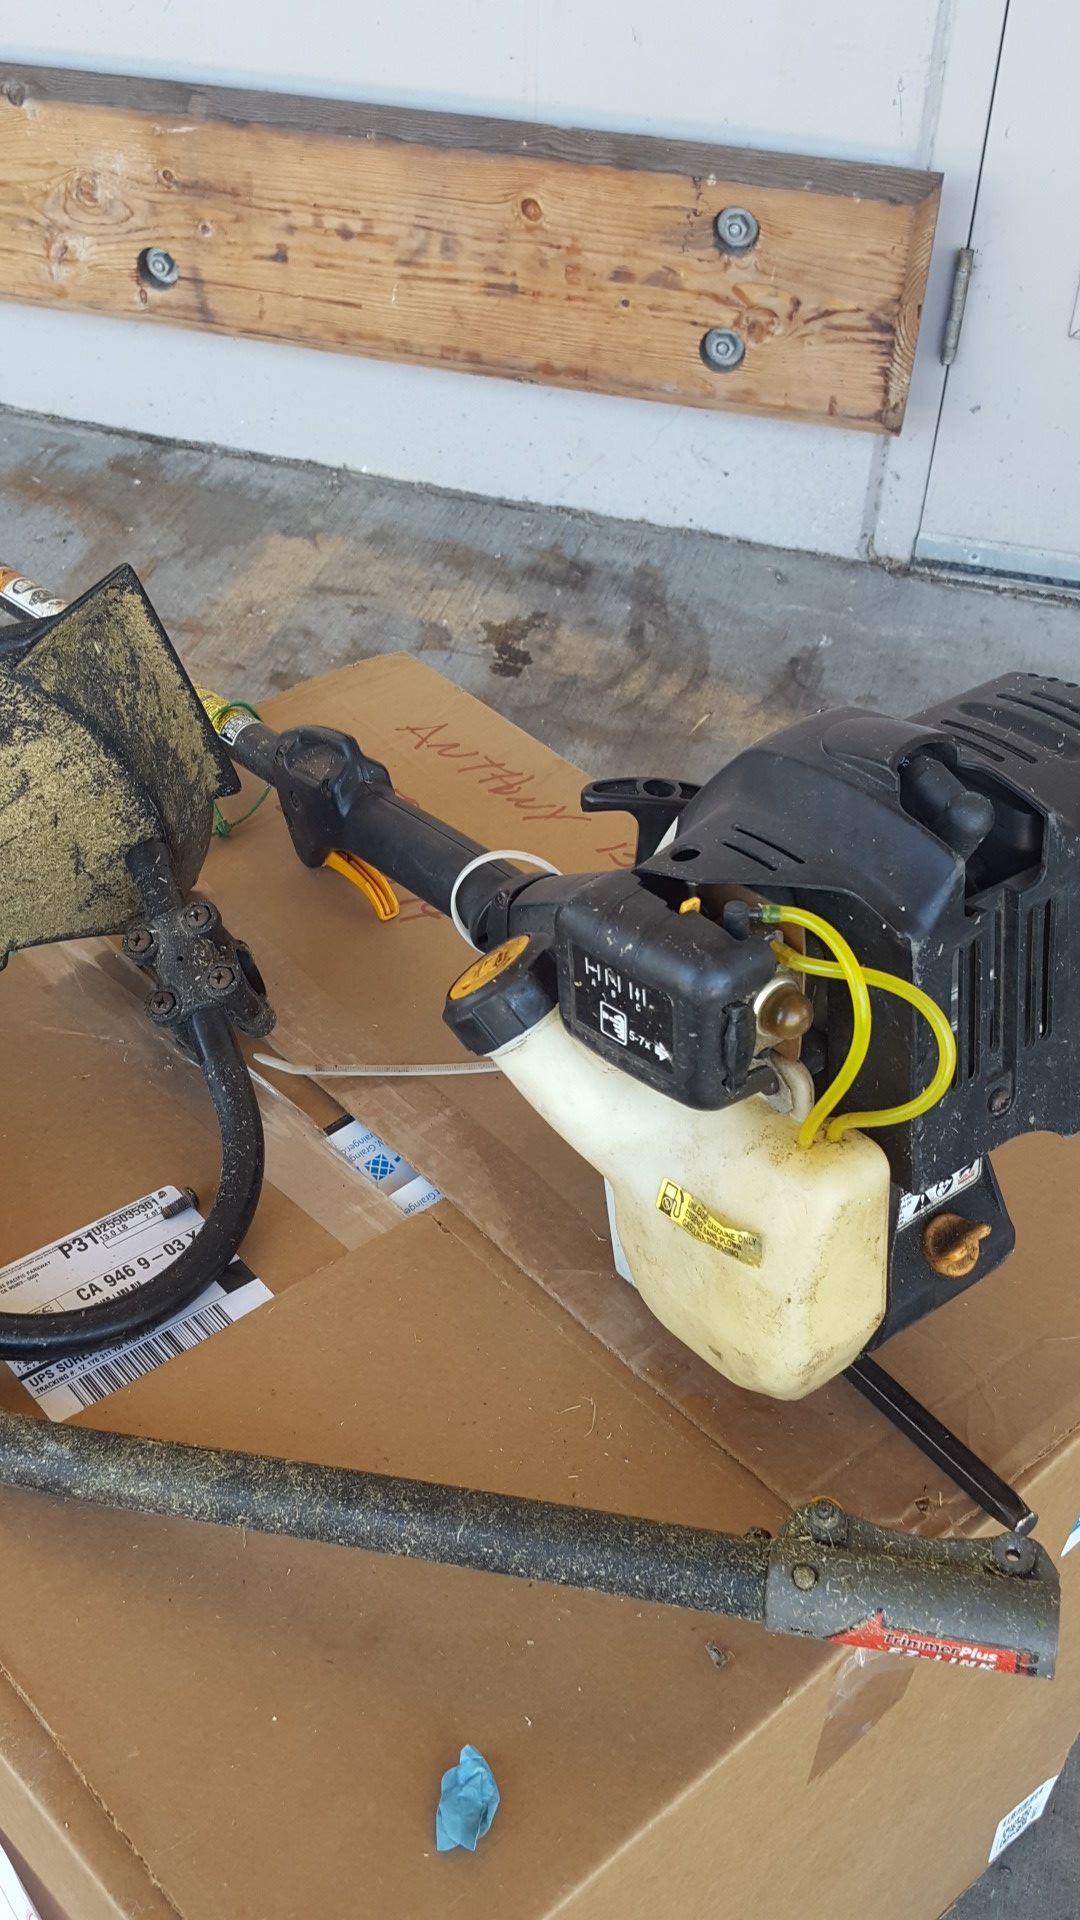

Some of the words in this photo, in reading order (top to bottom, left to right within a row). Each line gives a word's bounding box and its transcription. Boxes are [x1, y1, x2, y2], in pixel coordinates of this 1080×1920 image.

[76, 1282, 103, 1301] CA
[28, 1369, 55, 1388] UPS
[34, 1374, 69, 1395] TRACKING
[884, 1633, 999, 1662] TrimmerPlus
